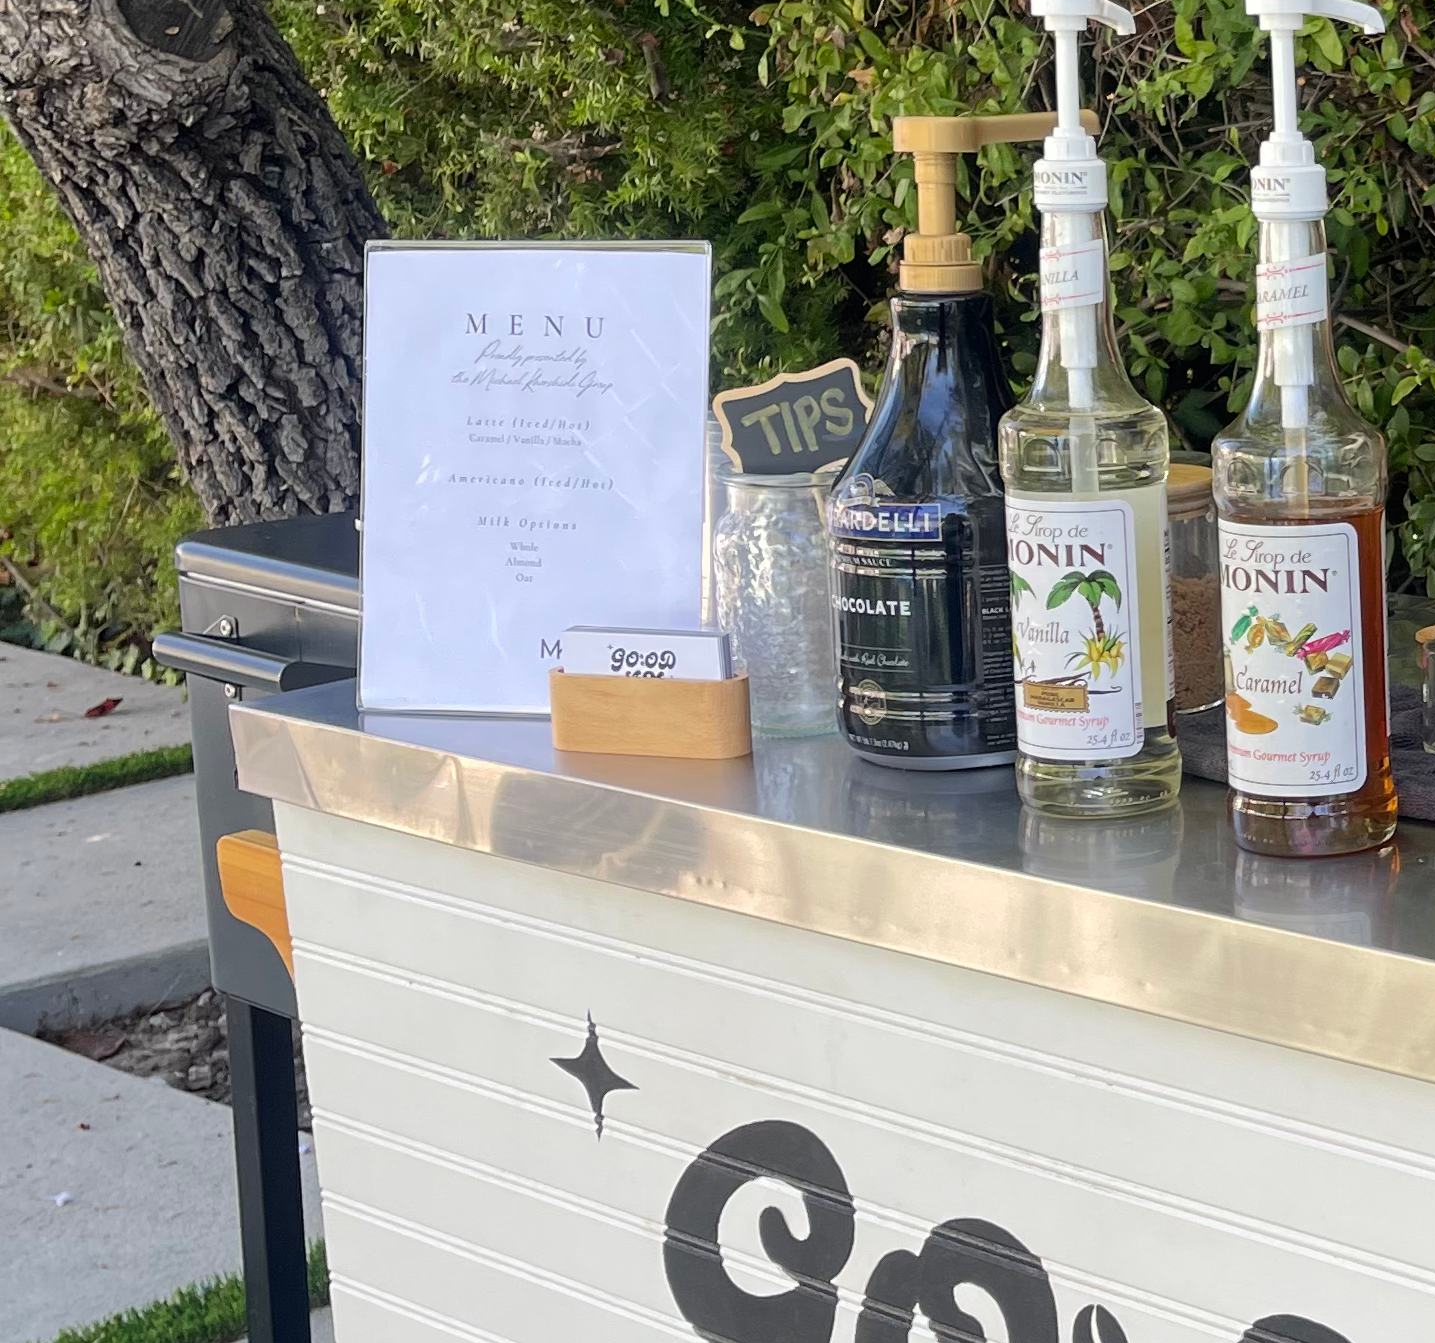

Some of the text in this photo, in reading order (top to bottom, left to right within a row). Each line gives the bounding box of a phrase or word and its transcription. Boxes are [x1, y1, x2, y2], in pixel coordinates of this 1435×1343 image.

[465, 312, 605, 339] MENU
[466, 416, 591, 432] Latte (Iced/Hot)
[740, 387, 855, 455] TIPS
[468, 433, 505, 444] Caramel
[513, 434, 545, 445] Vanilla
[552, 436, 582, 447] Mocha
[448, 473, 614, 491] Americano (Iced/Hot)
[477, 515, 578, 531] Milk Options
[1008, 513, 1088, 543] Le Sirop de
[510, 541, 539, 552] Whole
[1223, 538, 1312, 570] Le Sirop de
[505, 556, 543, 568] Almond
[515, 572, 534, 583] Oat
[831, 594, 911, 616] CHOCOLATE
[1016, 617, 1070, 644] Vanilla
[1236, 665, 1303, 695] Caramel
[1036, 713, 1076, 727] Gourmet
[1078, 715, 1110, 732] Syrup
[1253, 749, 1297, 763] Gourmet
[1299, 751, 1331, 767] Syrup
